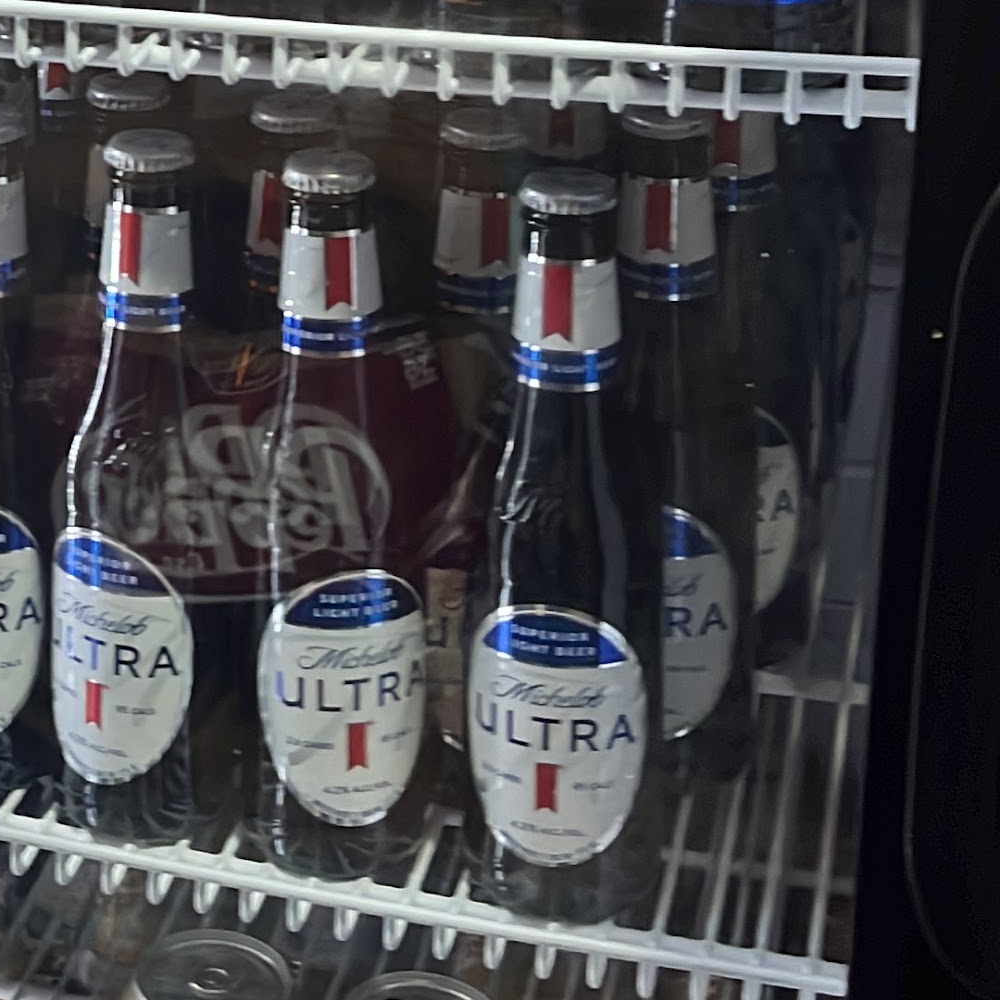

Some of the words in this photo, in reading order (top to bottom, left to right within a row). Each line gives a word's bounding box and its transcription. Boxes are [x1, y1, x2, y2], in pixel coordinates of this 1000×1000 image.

[56, 624, 179, 678] LTRA
[509, 638, 550, 654] IGHT
[275, 660, 424, 712] ULTRA
[476, 691, 636, 752] ULTRA
